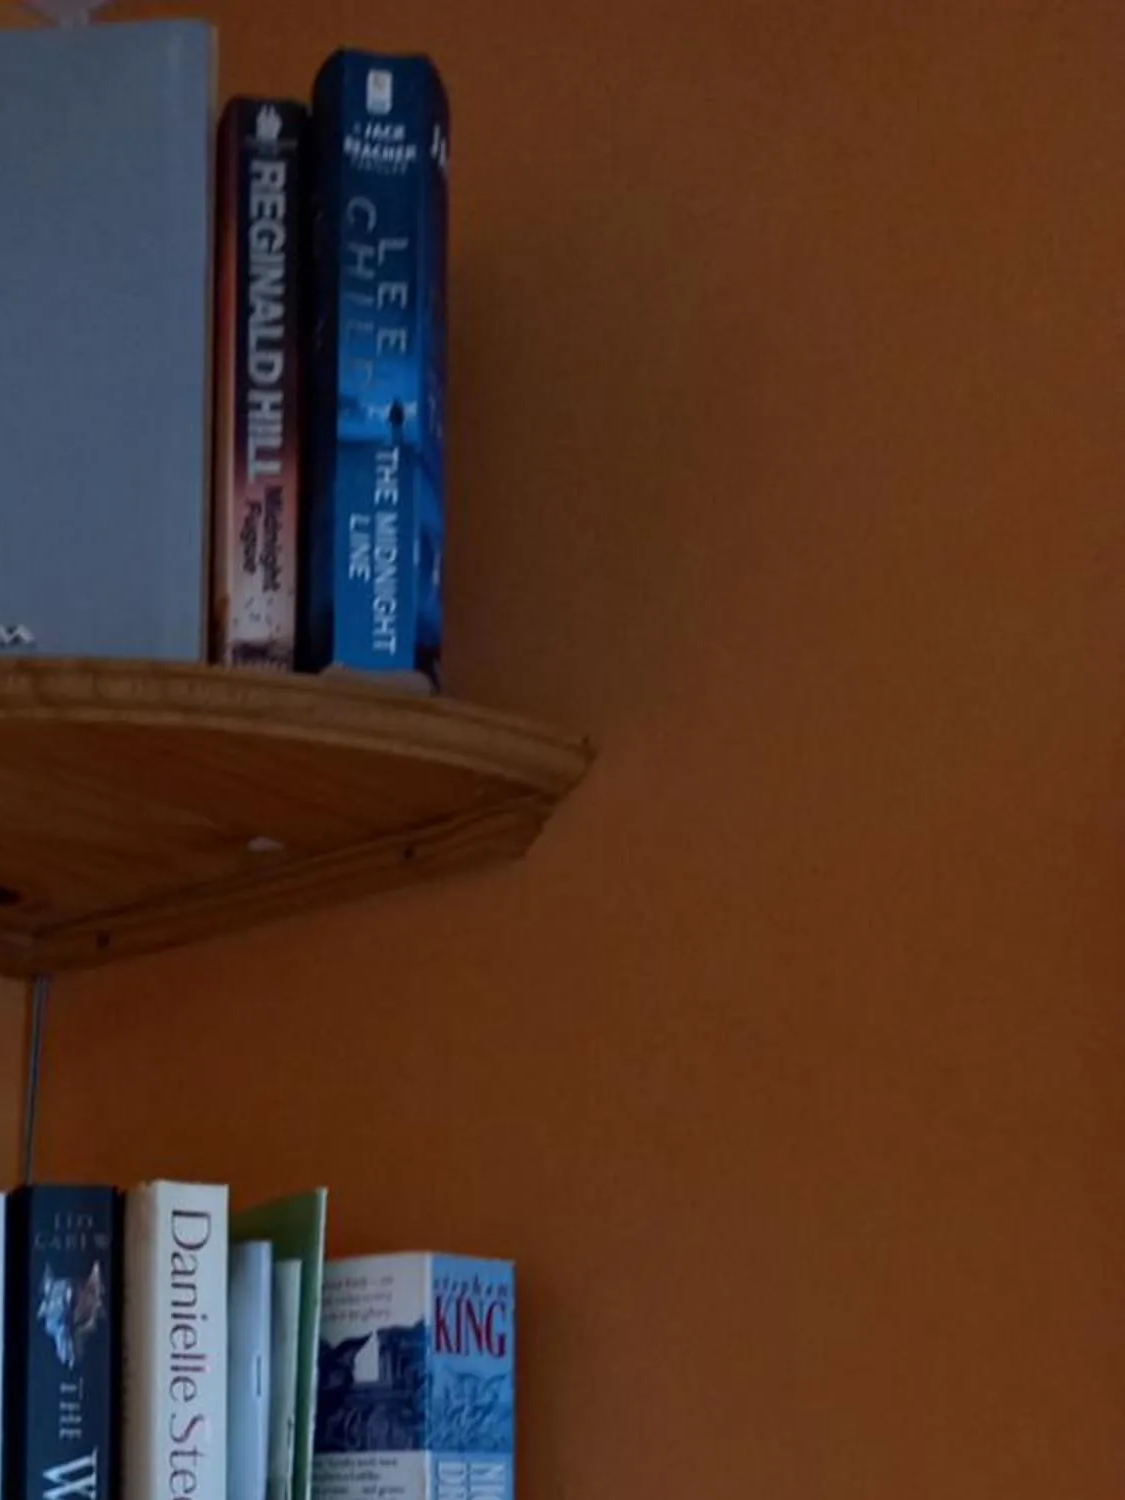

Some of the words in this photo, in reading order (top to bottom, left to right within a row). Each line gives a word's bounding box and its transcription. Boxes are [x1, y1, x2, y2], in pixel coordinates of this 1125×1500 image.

[247, 159, 286, 384] REGINALD
[377, 237, 409, 357] LEE
[246, 387, 284, 484] HILL
[374, 446, 400, 506] THE
[348, 512, 371, 582] LINE
[372, 511, 399, 656] MIDNIGHT
[168, 1207, 212, 1404] Danielle
[434, 1294, 507, 1358] KING
[58, 1376, 84, 1440] THE
